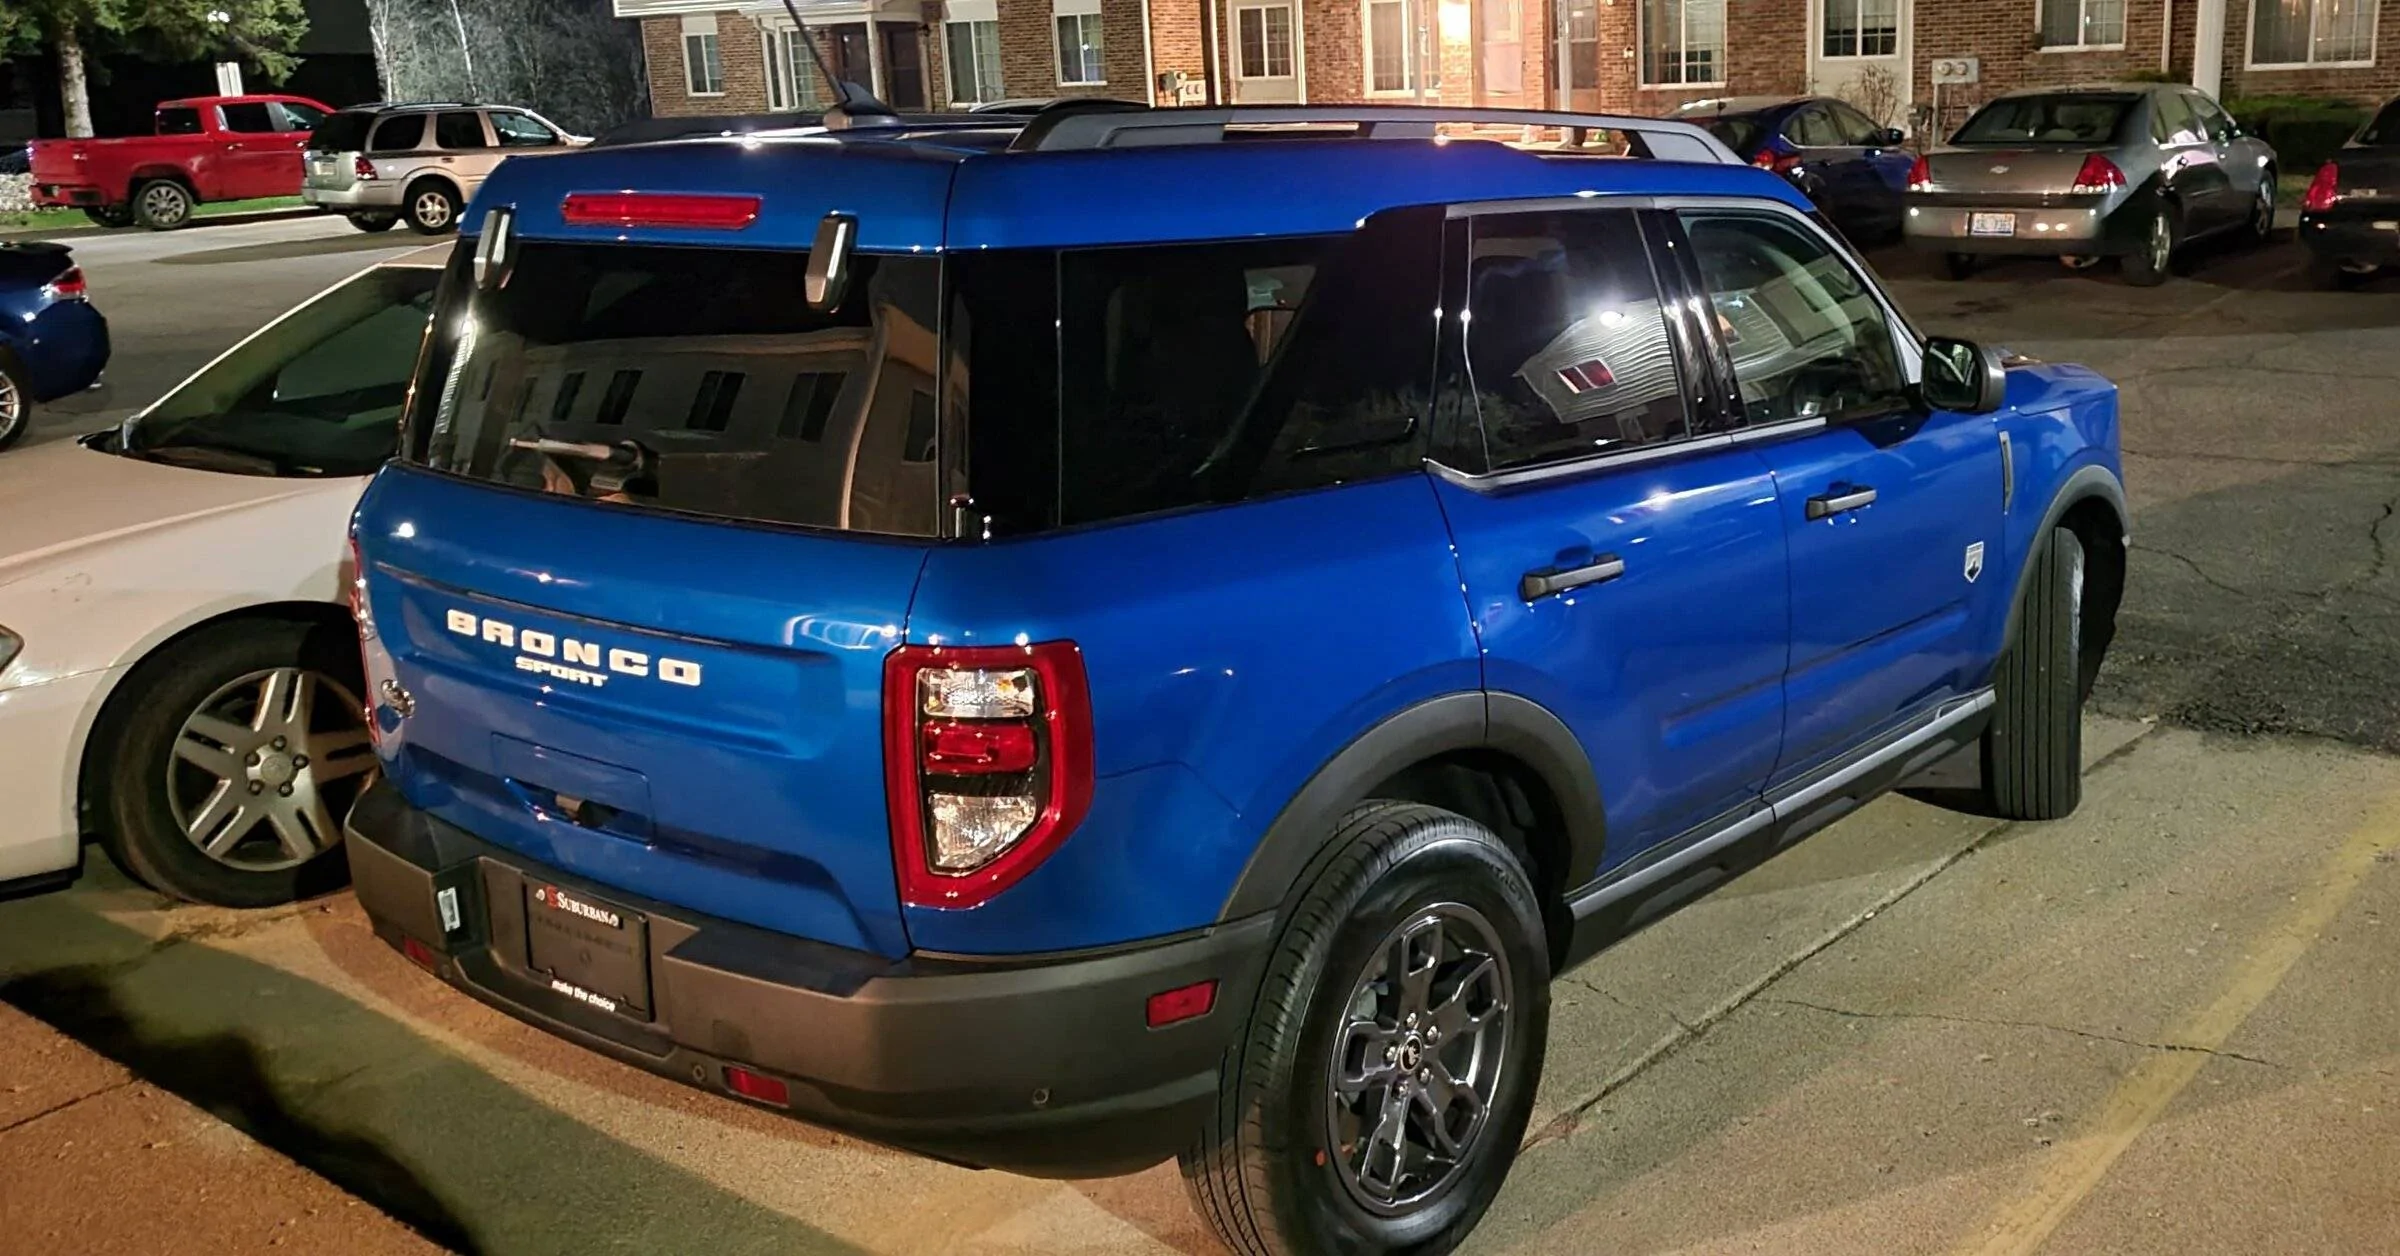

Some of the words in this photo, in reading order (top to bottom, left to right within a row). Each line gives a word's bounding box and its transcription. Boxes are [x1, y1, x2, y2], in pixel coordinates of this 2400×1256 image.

[447, 609, 701, 686] BRONCO
[515, 656, 608, 687] SPORT
[551, 980, 573, 997] make
[574, 986, 588, 1001] the
[588, 993, 616, 1012] choice
